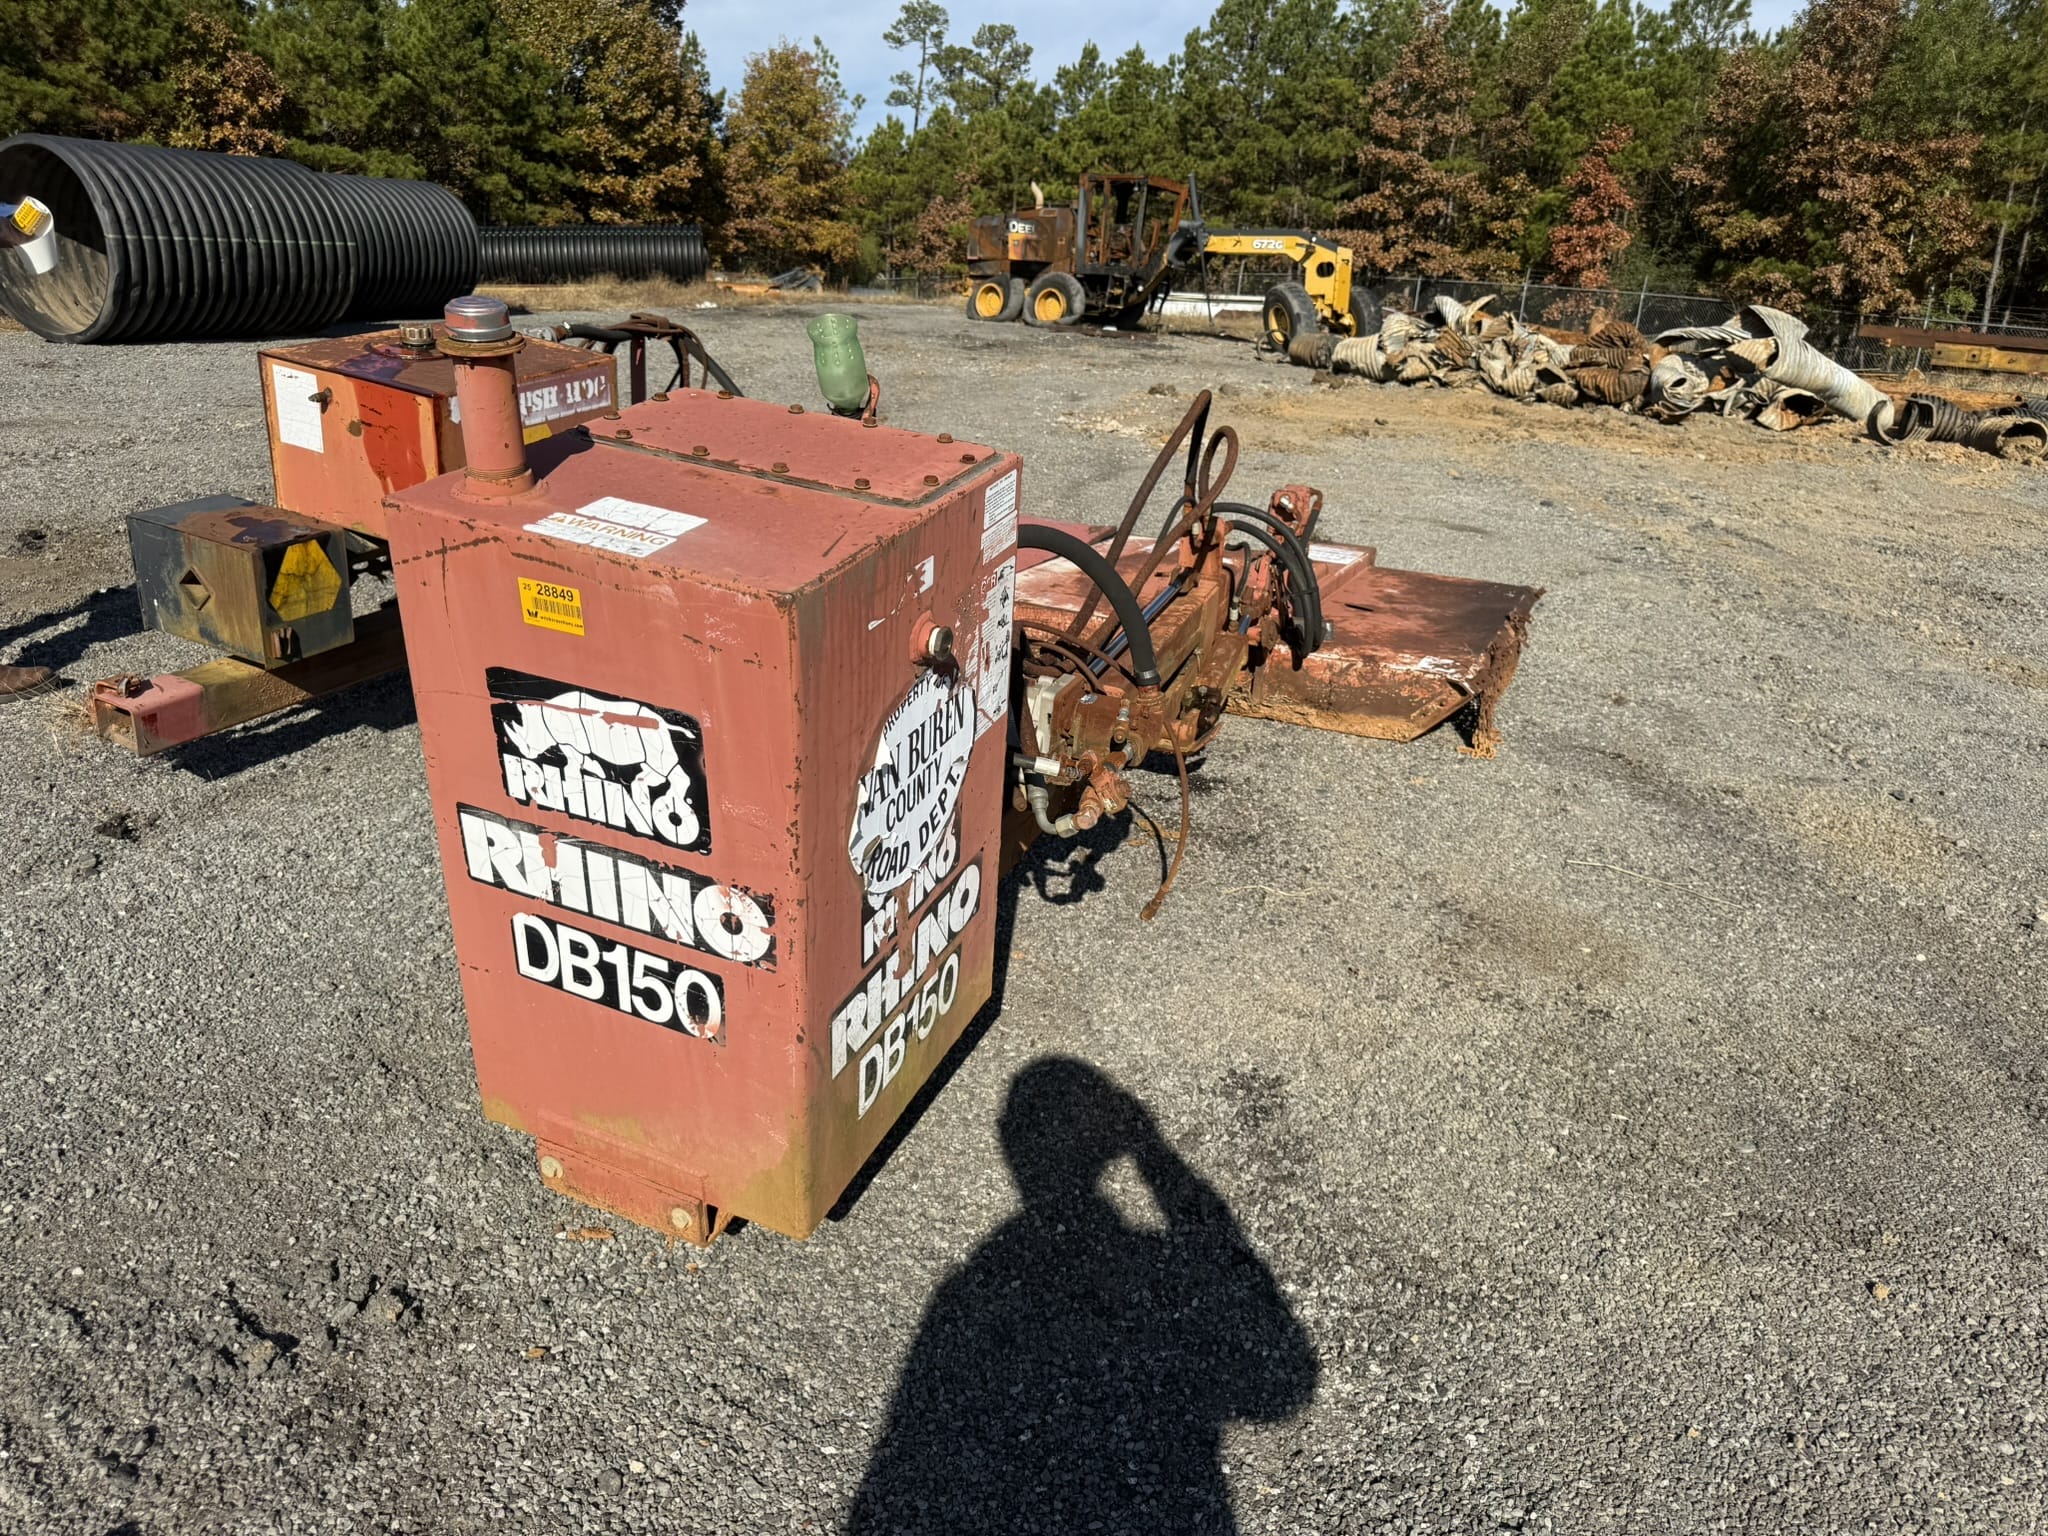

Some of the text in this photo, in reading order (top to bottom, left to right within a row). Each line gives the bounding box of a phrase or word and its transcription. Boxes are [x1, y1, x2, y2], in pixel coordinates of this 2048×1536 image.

[1009, 220, 1035, 233] DEE
[570, 517, 669, 546] WARNING
[536, 583, 574, 602] 28849
[860, 693, 965, 818] VAN BUREN
[886, 751, 943, 832] COUNTY
[460, 811, 771, 962] RHINO
[865, 841, 911, 882] ROAD
[512, 912, 722, 1039] DB150
[831, 864, 980, 1080] RHINO
[858, 952, 959, 1120] DB150
